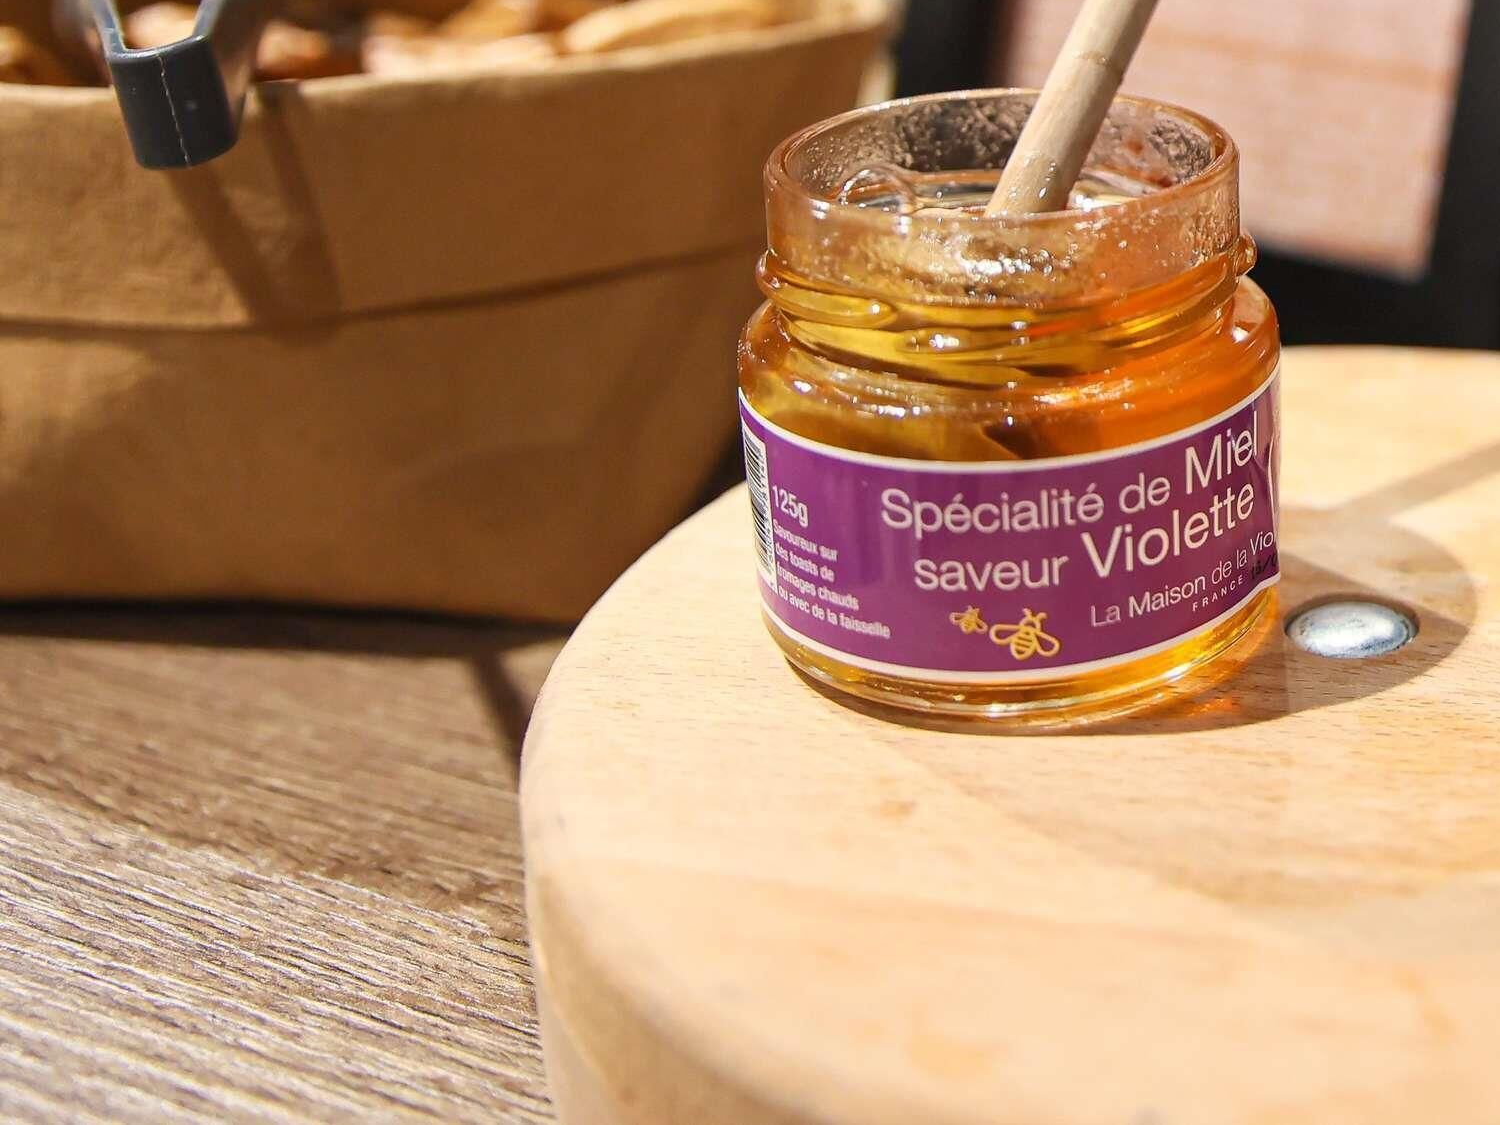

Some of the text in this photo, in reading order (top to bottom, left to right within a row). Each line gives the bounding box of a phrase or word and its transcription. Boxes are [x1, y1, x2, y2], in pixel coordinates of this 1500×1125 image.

[772, 484, 809, 528] 125g
[881, 410, 1258, 541] Spécialité de Miel
[914, 483, 1254, 592] saveur Violette
[788, 592, 811, 614] avec
[811, 603, 826, 620] de
[826, 608, 839, 625] la
[1090, 604, 1121, 627] La
[1128, 575, 1206, 618] Maison
[1211, 560, 1232, 585] de
[1236, 548, 1248, 570] la
[1192, 574, 1244, 612] FRANCE
